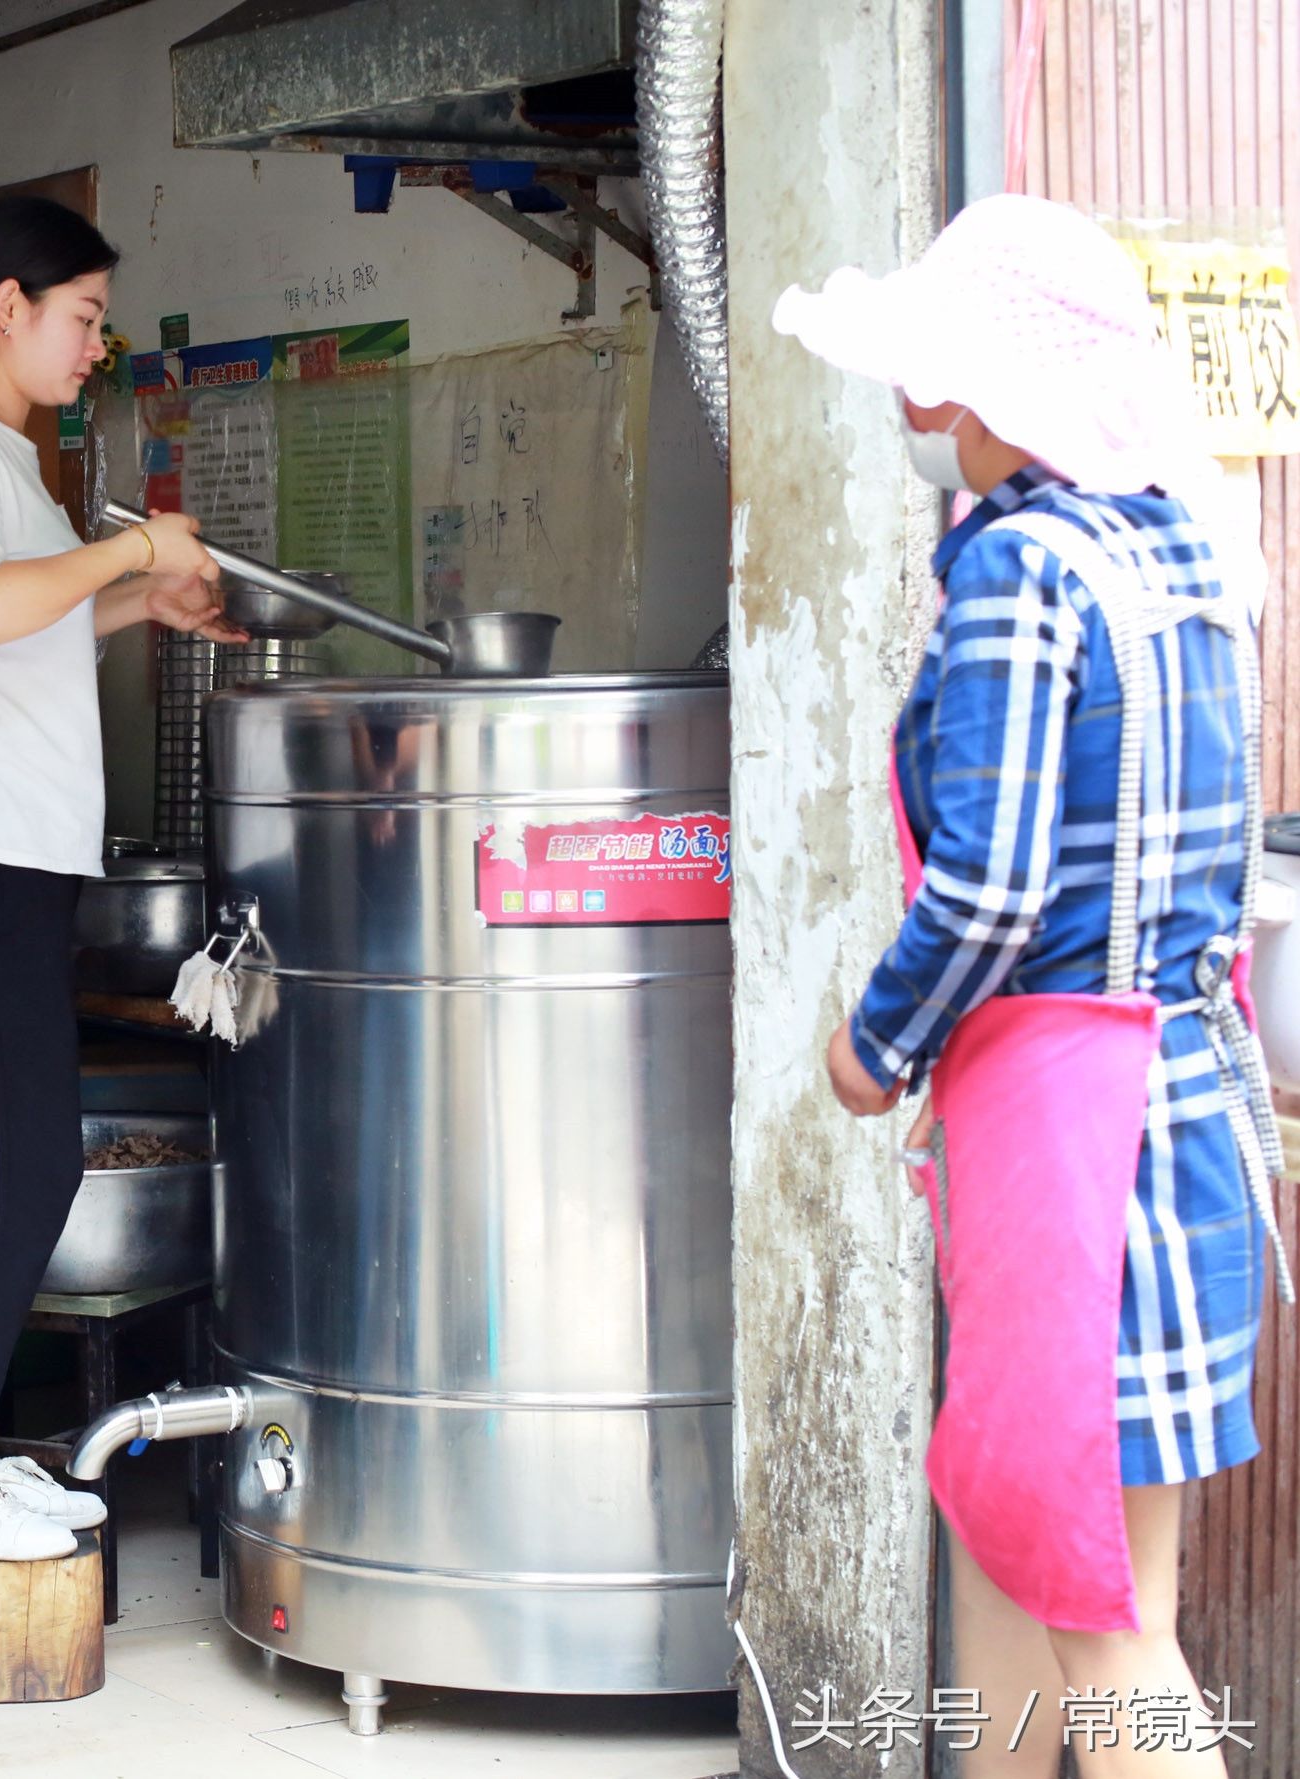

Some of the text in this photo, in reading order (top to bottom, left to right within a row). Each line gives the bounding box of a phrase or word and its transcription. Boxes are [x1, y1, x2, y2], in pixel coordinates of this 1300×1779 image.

[190, 358, 259, 387] 餐厅卫生管理制度
[460, 398, 531, 464] 自觉
[454, 489, 562, 568] 排队
[546, 833, 654, 861] 超强节能
